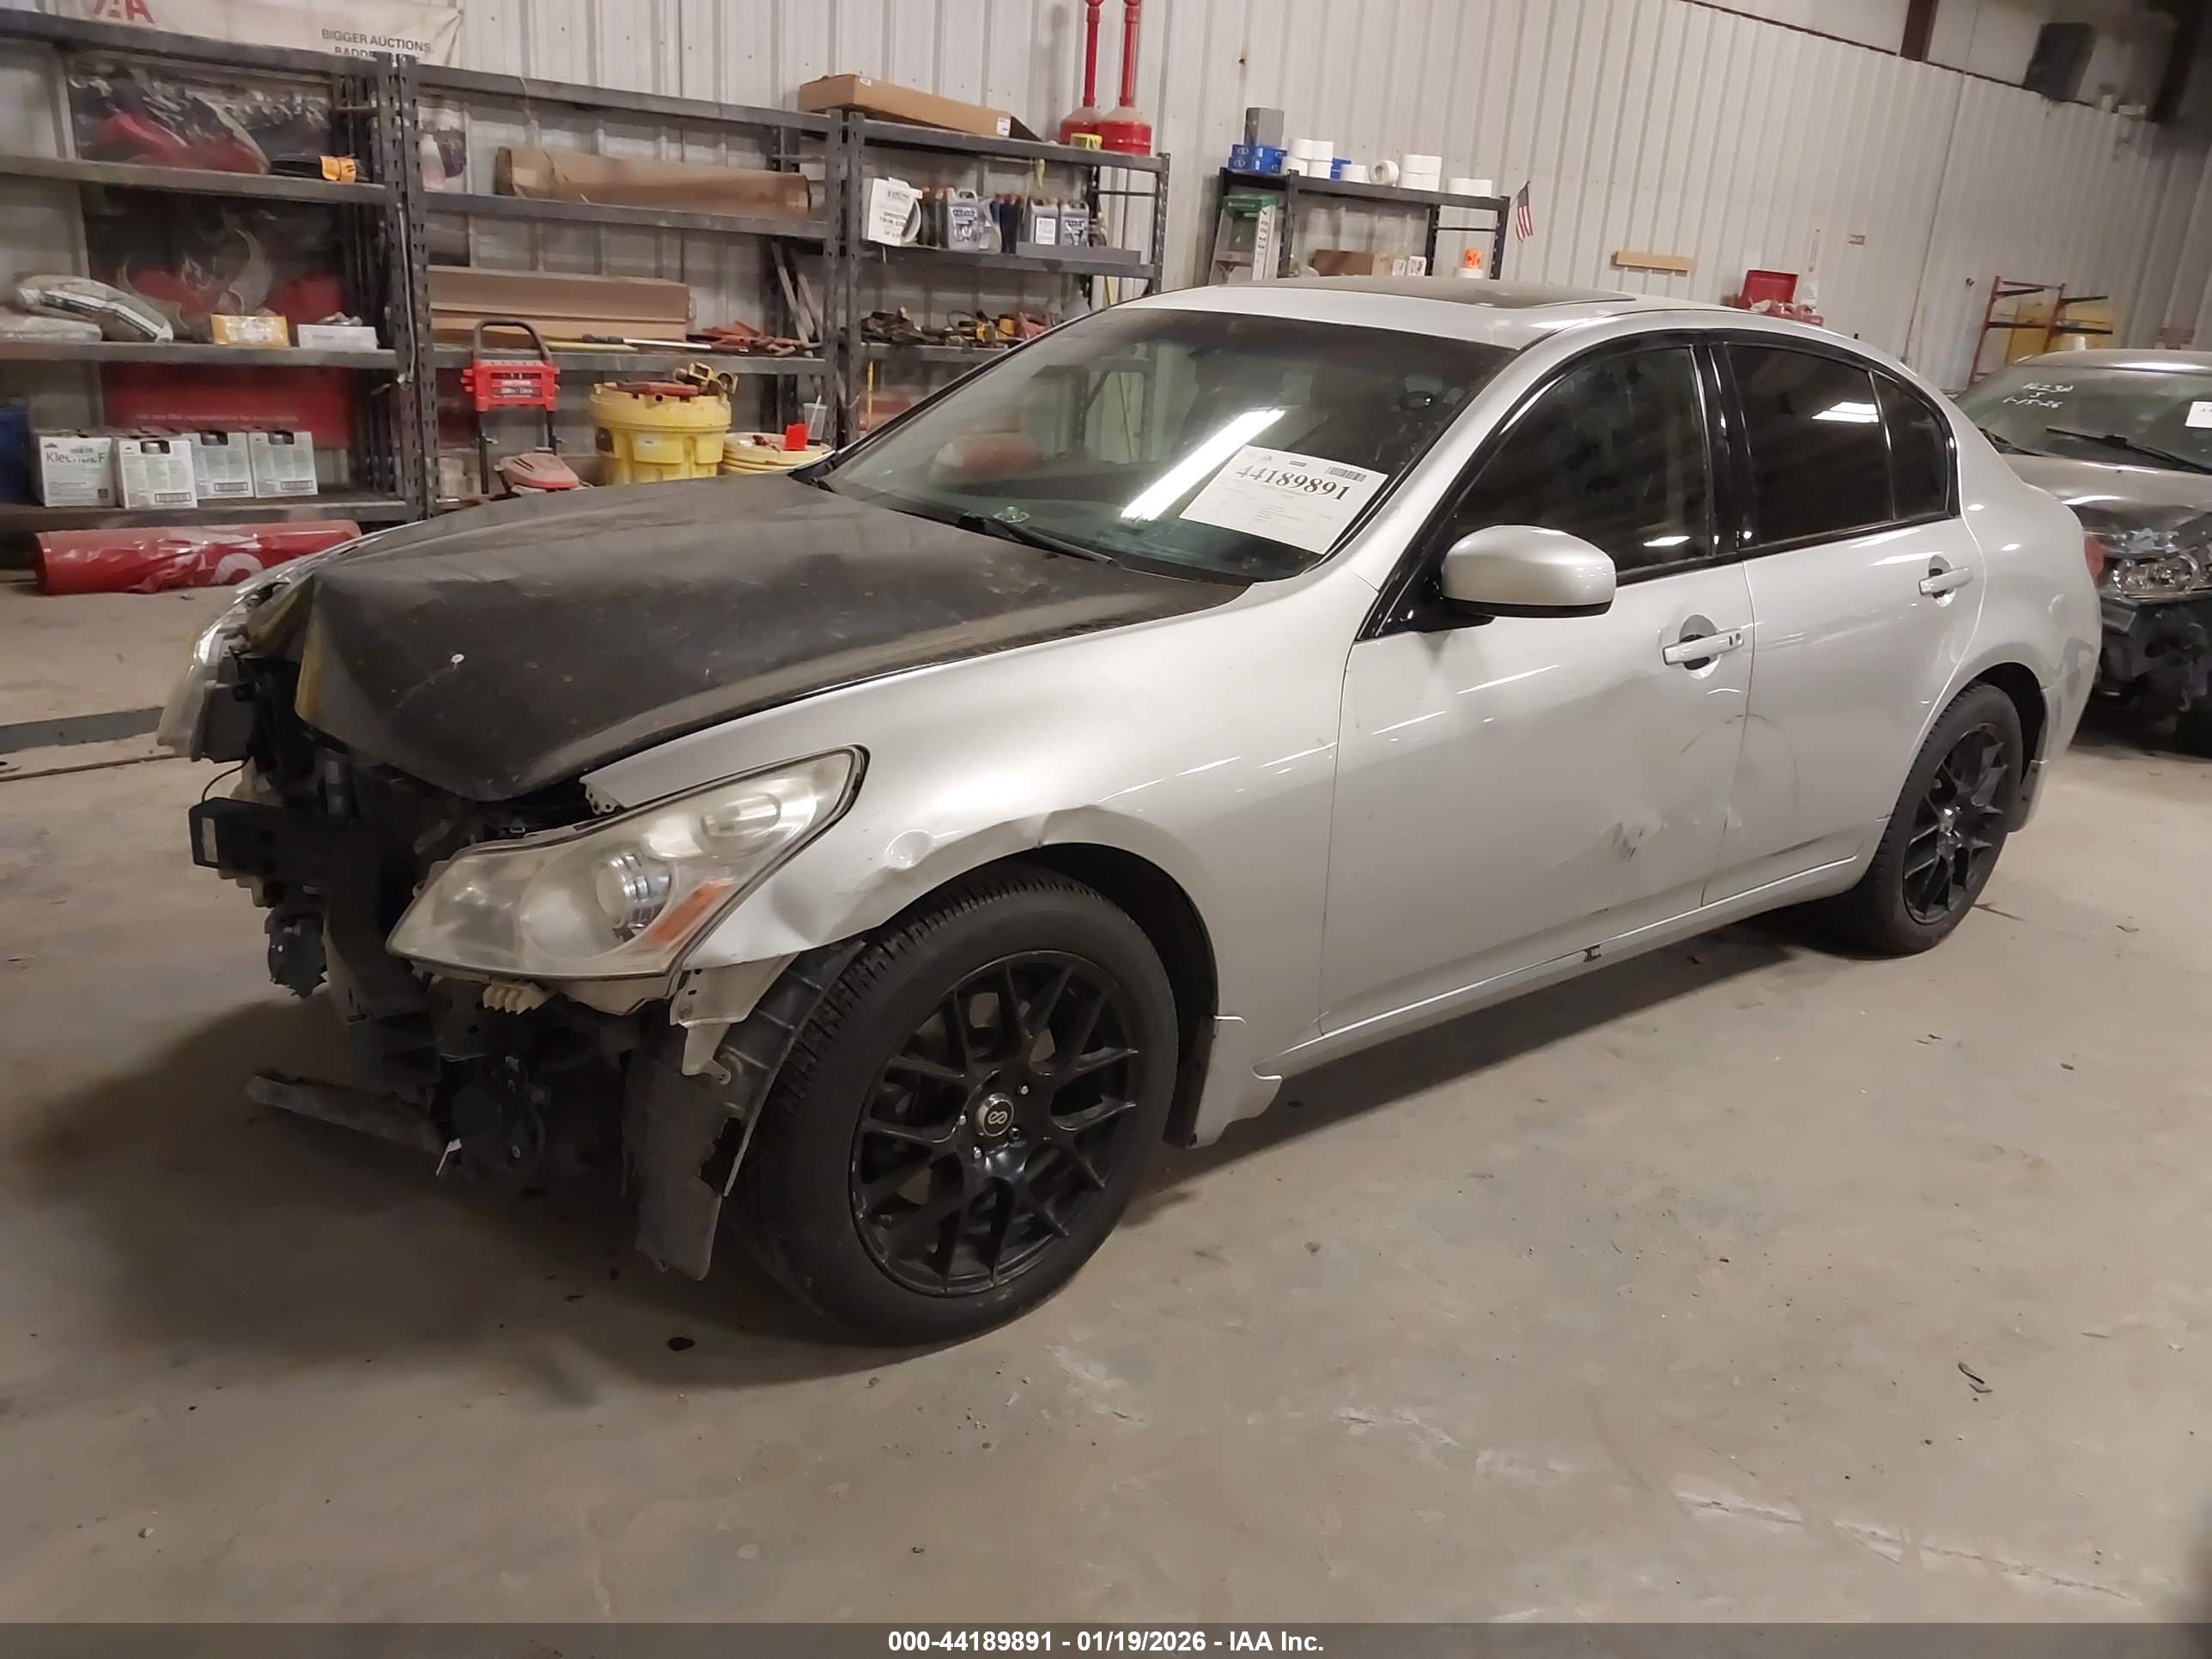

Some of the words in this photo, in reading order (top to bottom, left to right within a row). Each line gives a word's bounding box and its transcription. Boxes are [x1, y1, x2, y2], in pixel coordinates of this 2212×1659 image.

[321, 28, 368, 45] BIGGER
[370, 35, 432, 52] AUCTIONS
[1236, 465, 1352, 501] 44189891
